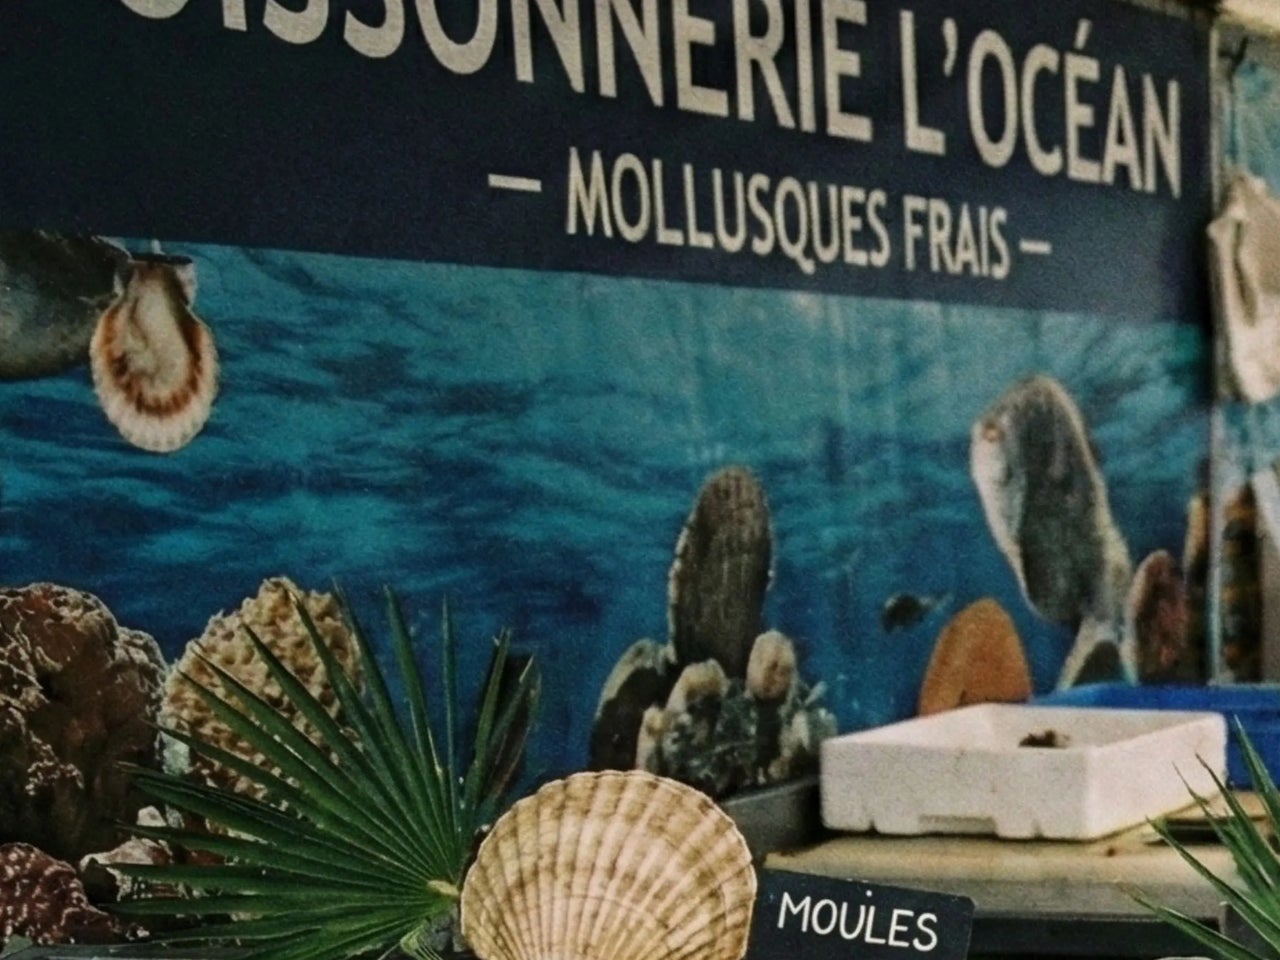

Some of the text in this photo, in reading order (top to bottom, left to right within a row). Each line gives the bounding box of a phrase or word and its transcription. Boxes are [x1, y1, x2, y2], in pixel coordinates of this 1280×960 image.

[900, 10, 1181, 199] L'OCÉAN
[566, 146, 1011, 279] MOLLUSQUES FRAIS
[776, 891, 938, 952] MOULES
